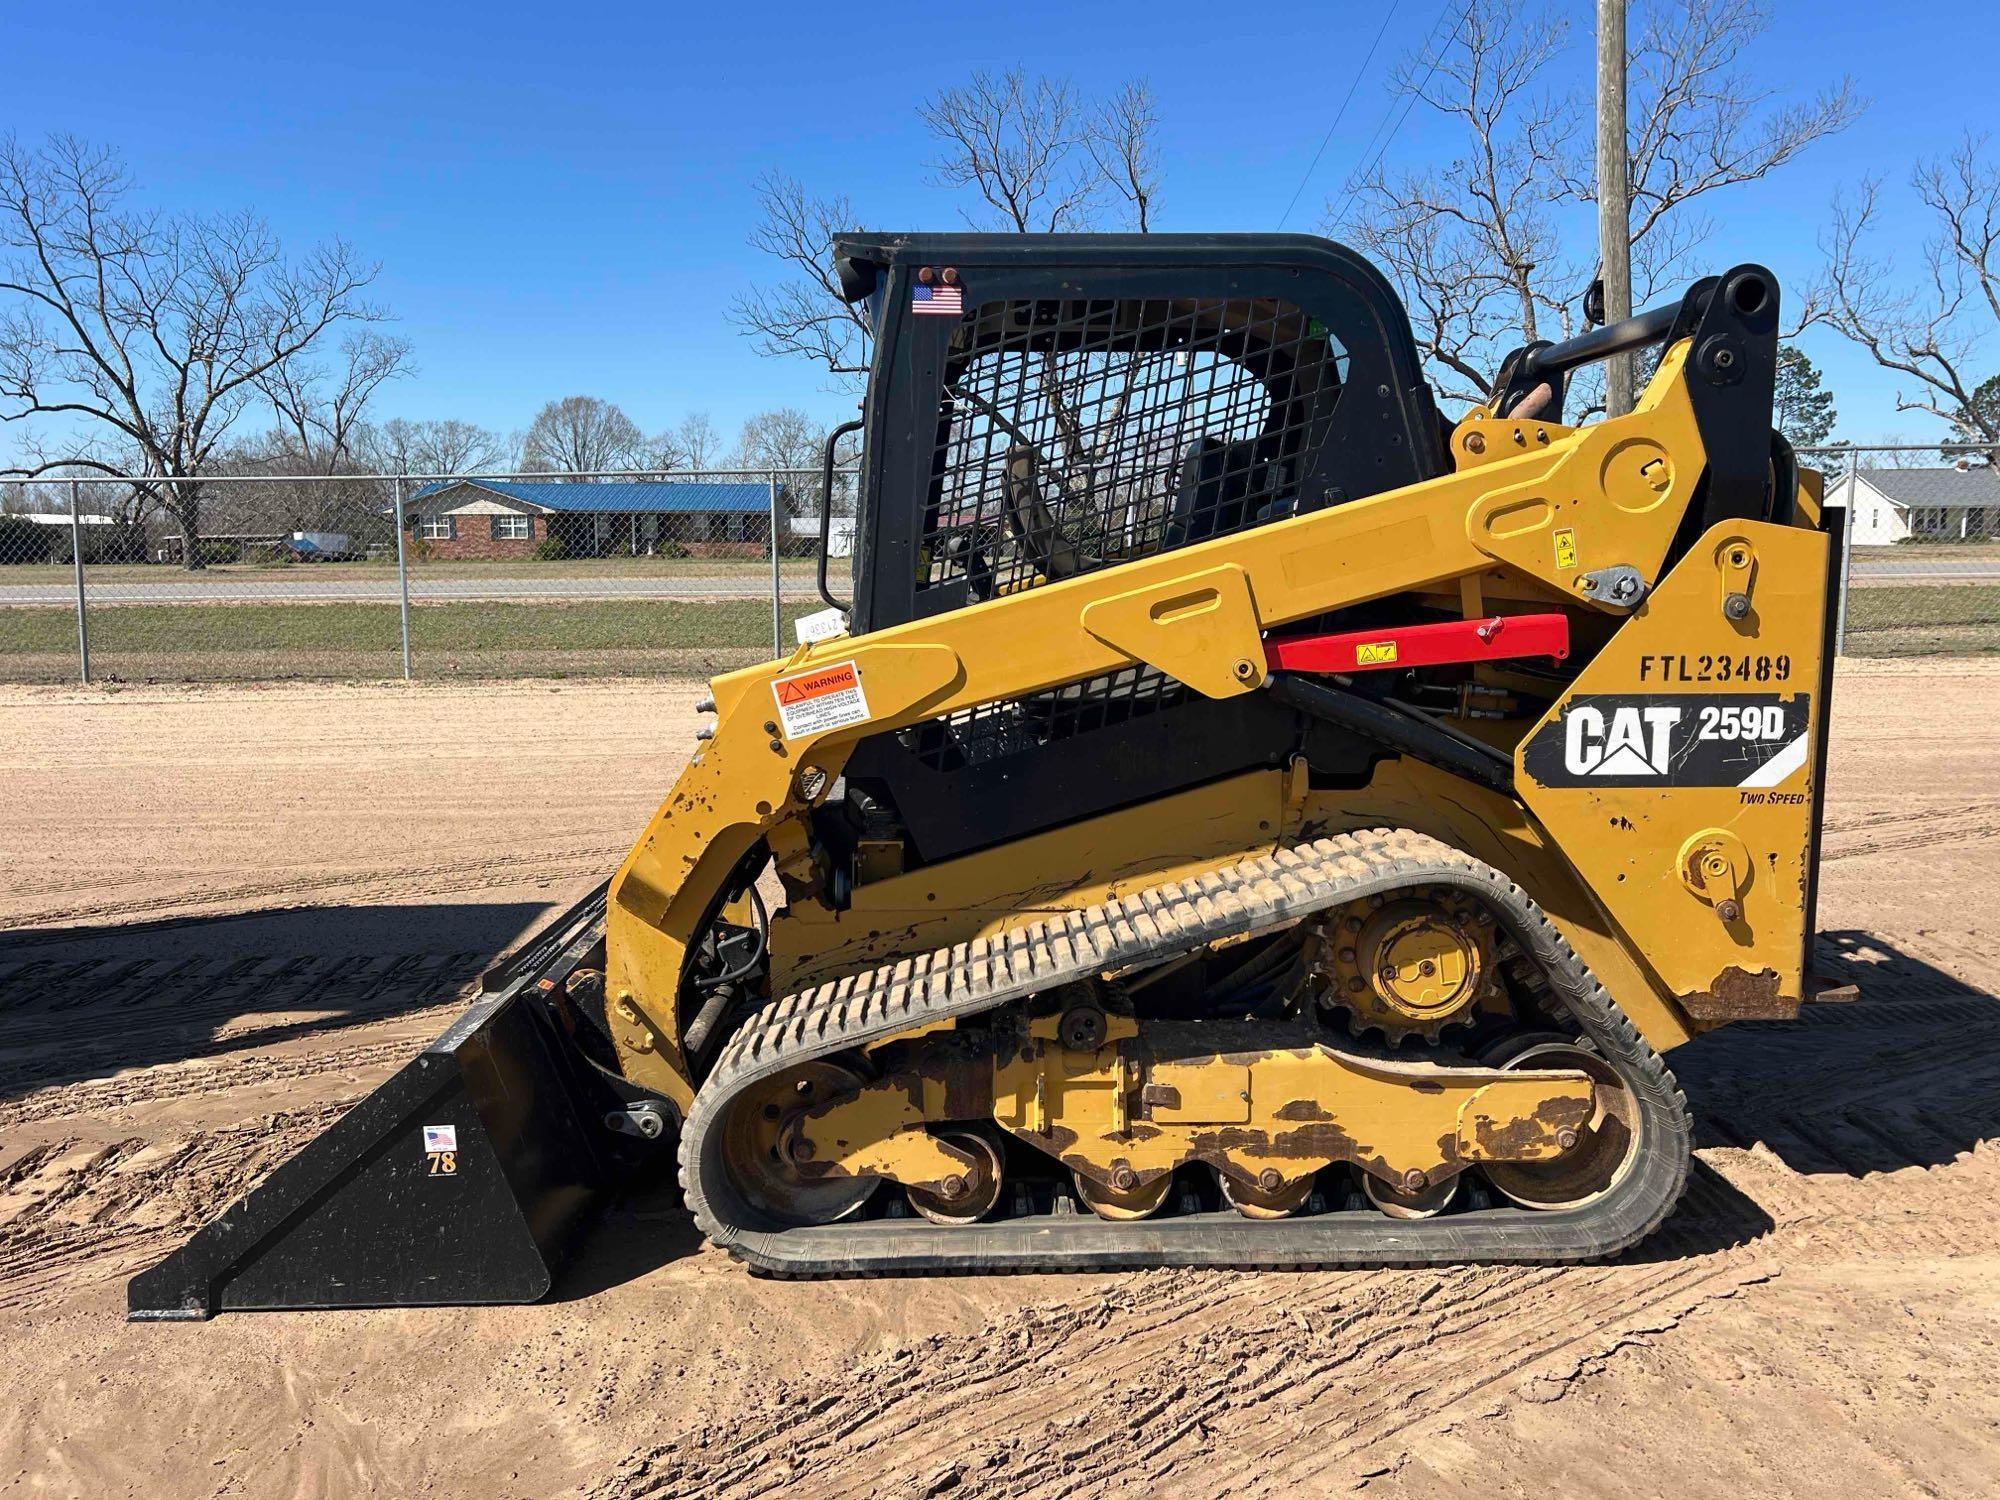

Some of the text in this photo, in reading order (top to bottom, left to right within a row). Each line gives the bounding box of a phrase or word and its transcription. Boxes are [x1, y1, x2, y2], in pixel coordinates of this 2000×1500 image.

[1640, 654, 1791, 682] FTL23489
[804, 672, 852, 691] WARNING
[821, 693, 845, 702] OPERATE
[787, 705, 816, 716] EQUIPMENT
[796, 708, 824, 719] OVERHEAD
[838, 699, 860, 708] VOLTAGE
[1565, 706, 1785, 776] CAT 259D
[426, 1152, 456, 1174] 78
